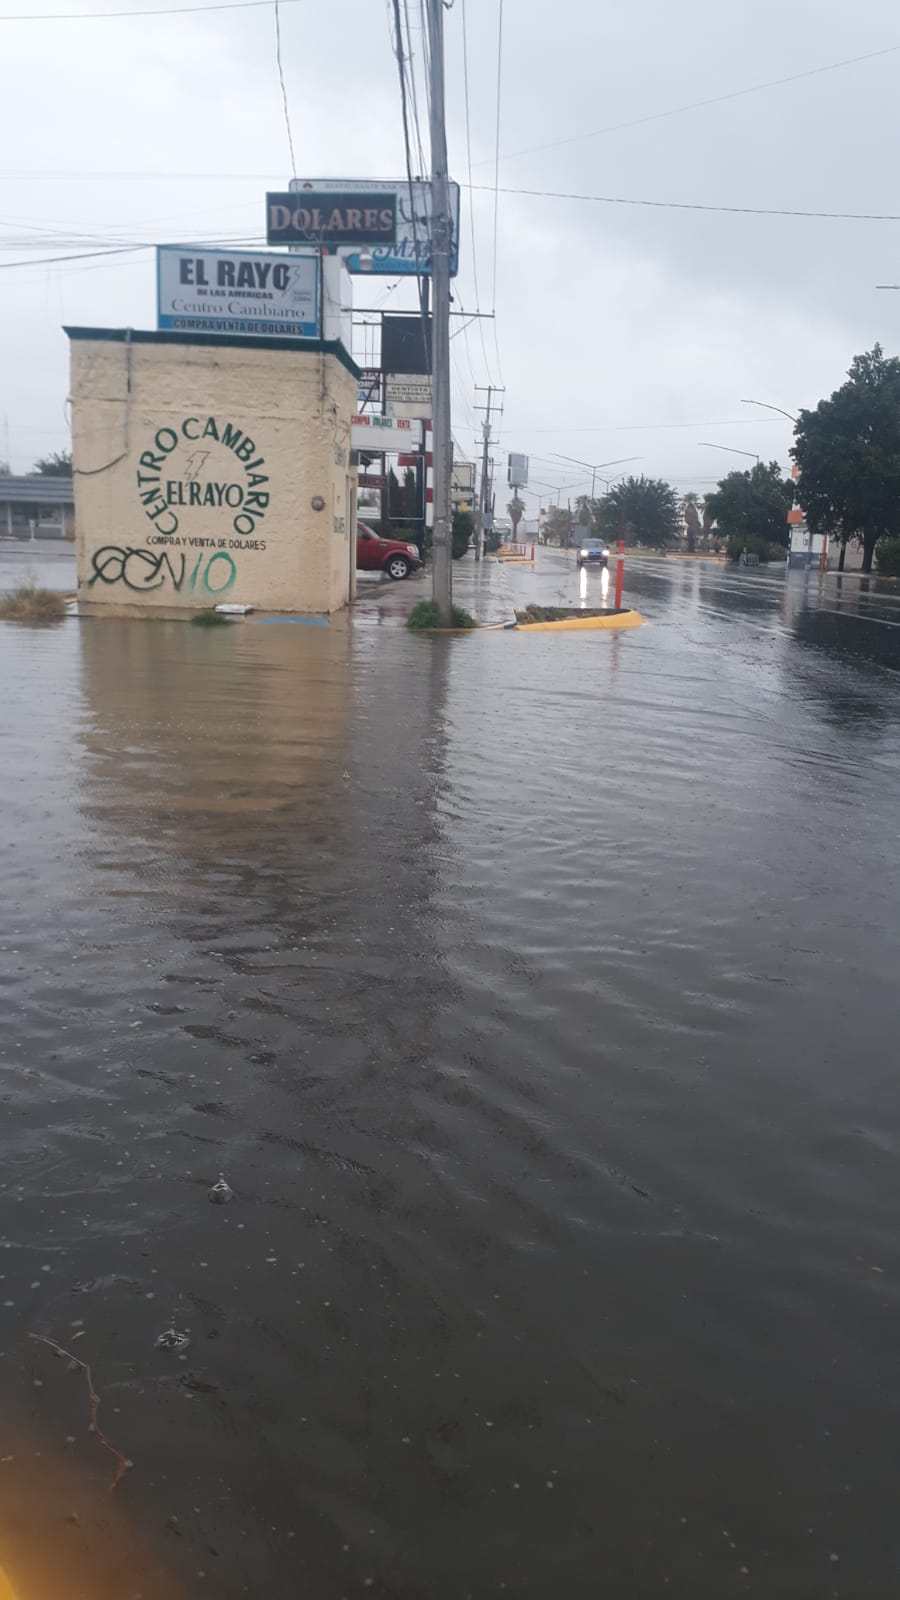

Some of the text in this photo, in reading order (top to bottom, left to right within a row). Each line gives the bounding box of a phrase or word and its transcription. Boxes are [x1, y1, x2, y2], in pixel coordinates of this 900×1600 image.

[269, 204, 394, 232] DOLARES
[179, 258, 291, 291] EL RAYO
[228, 290, 274, 300] AMERICAS
[171, 298, 305, 319] Centro Cambiario
[174, 319, 303, 335] COMPRA VENTA DE DOLARES
[137, 416, 270, 536] CENTRO CAMBIARIO
[166, 480, 244, 509] EL RAYO
[146, 535, 267, 551] COMPRA Y VENTA DE DOLARES
